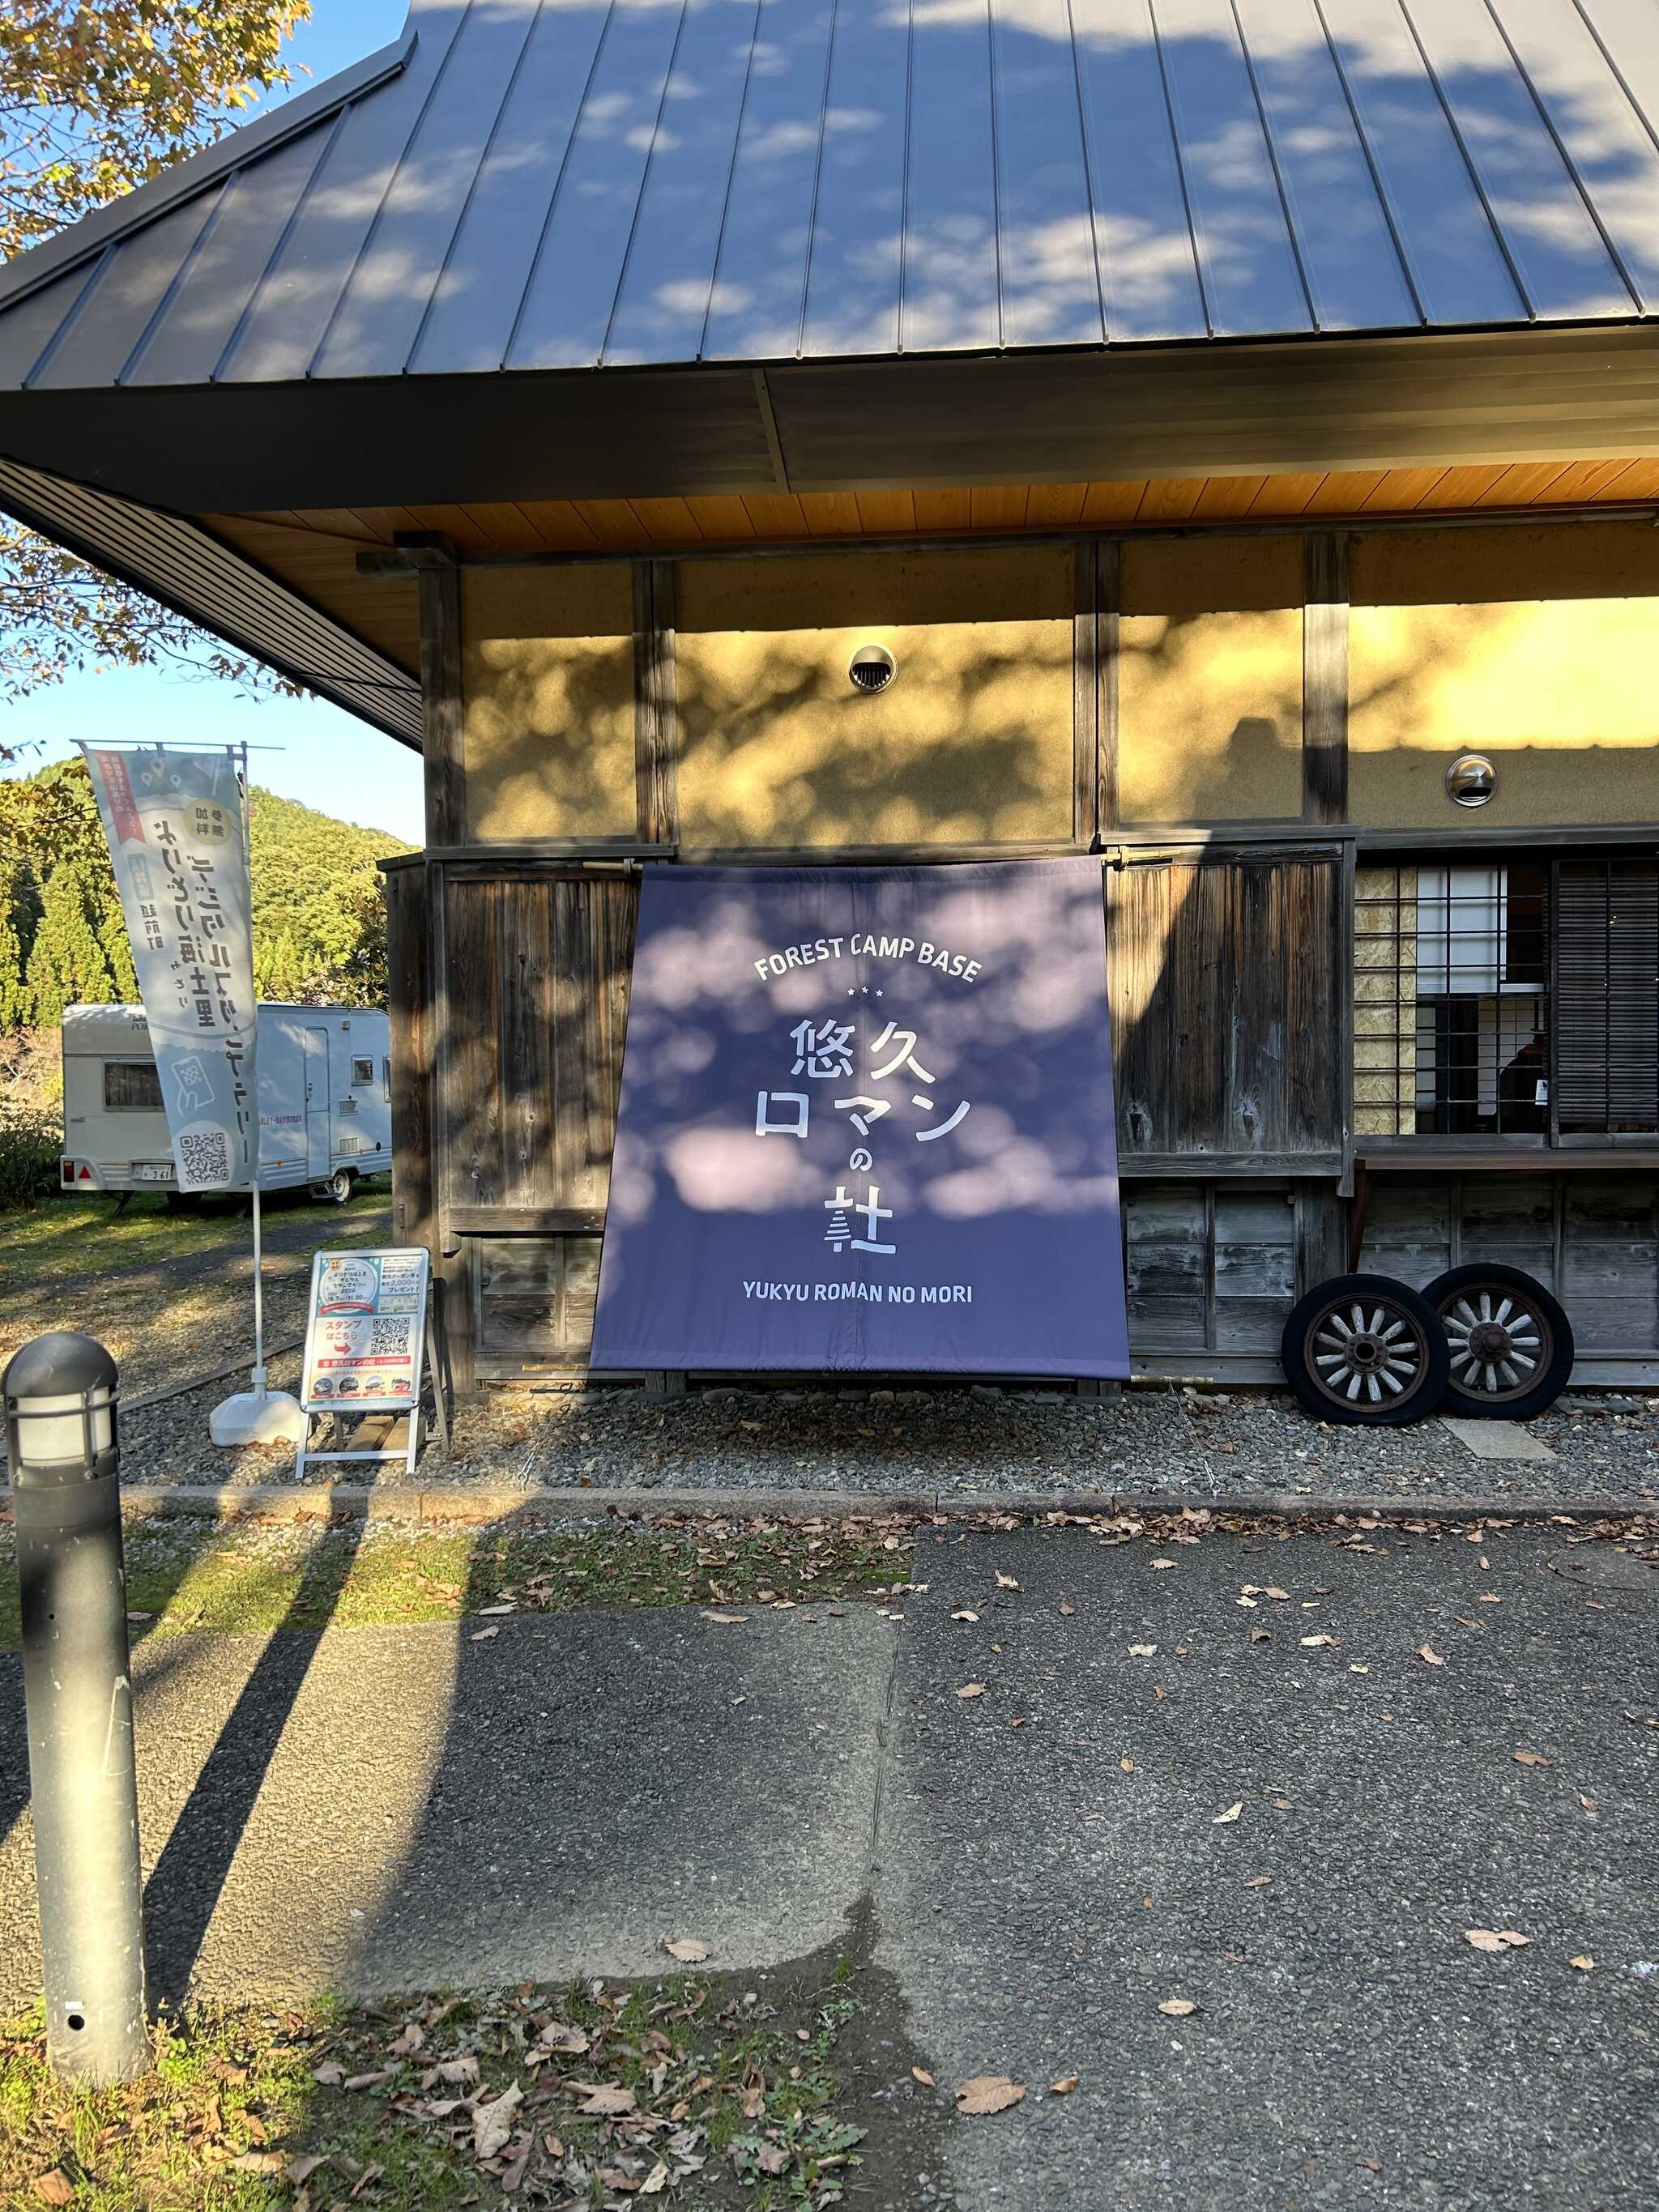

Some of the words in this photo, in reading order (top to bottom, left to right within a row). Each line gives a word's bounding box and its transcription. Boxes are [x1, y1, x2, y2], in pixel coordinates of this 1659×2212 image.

[754, 937, 843, 981] FOREST
[851, 933, 915, 958] CAMP
[917, 942, 982, 982] BASE
[790, 1019, 936, 1084] 悠久
[755, 1091, 970, 1141] ロマン
[849, 1148, 873, 1171] の
[743, 1281, 809, 1301] YUKYU
[814, 1281, 882, 1302] ROMAN
[888, 1286, 915, 1303] NO
[921, 1285, 972, 1303] MORI
